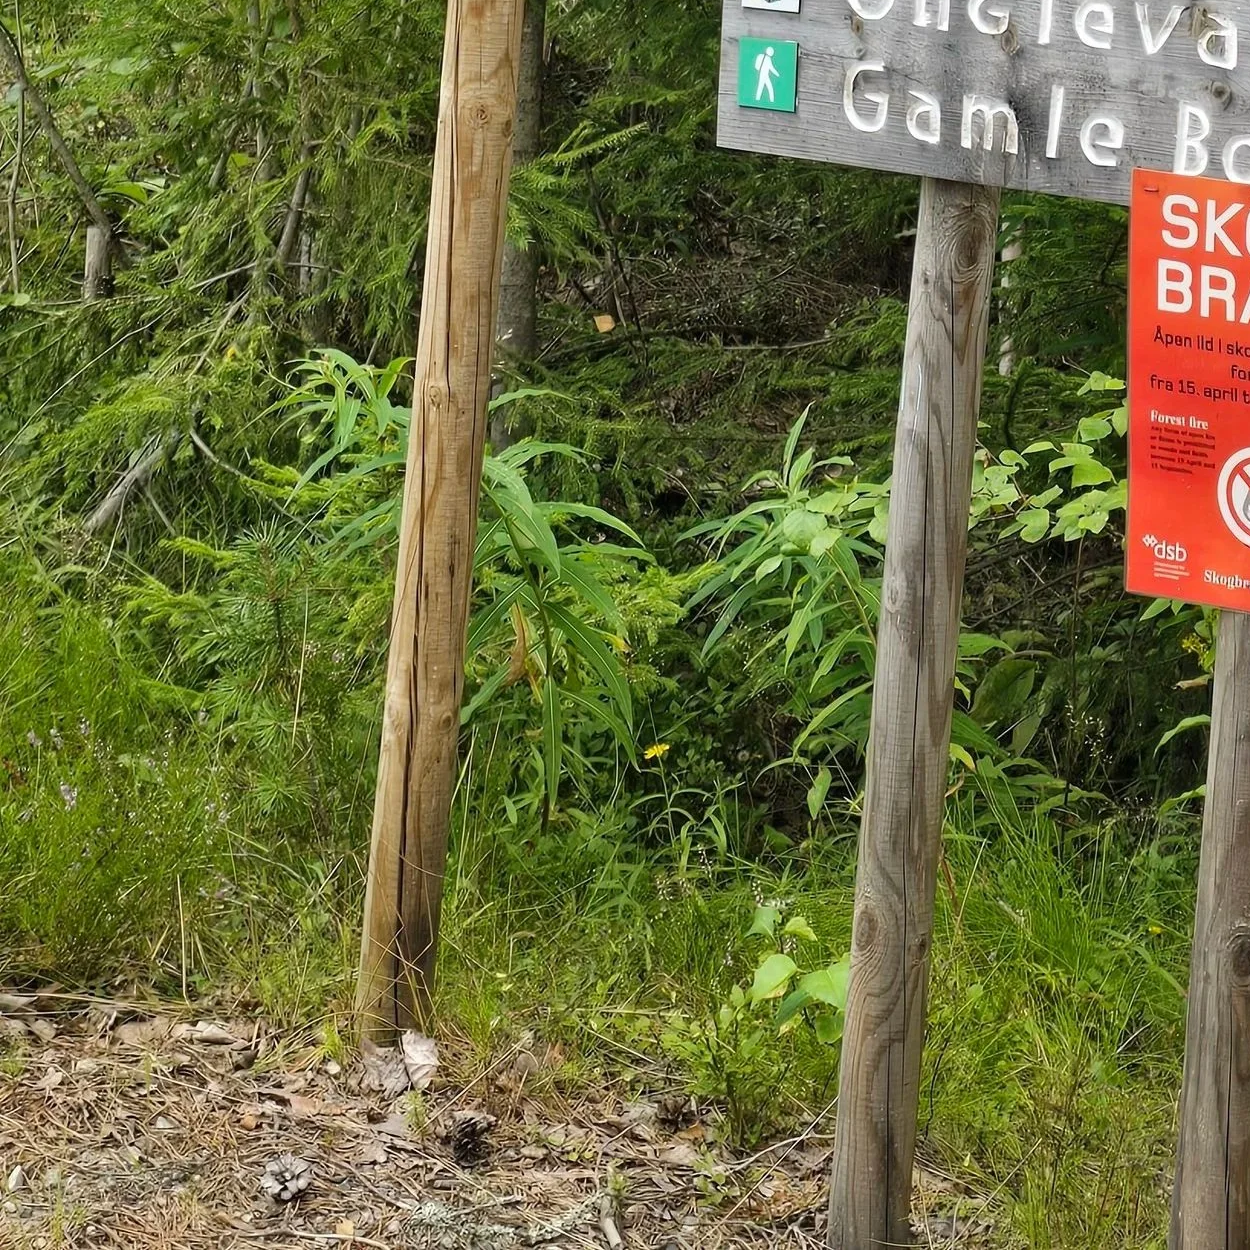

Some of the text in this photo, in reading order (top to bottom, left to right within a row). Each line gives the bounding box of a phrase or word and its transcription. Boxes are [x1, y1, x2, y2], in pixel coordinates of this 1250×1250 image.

[843, 59, 1124, 168] Gamle
[1153, 324, 1192, 348] Åpen
[1150, 374, 1174, 392] fra
[1178, 379, 1200, 396] 15.
[1203, 384, 1238, 403] april
[1150, 409, 1186, 427] Forest
[1154, 540, 1188, 562] dsb
